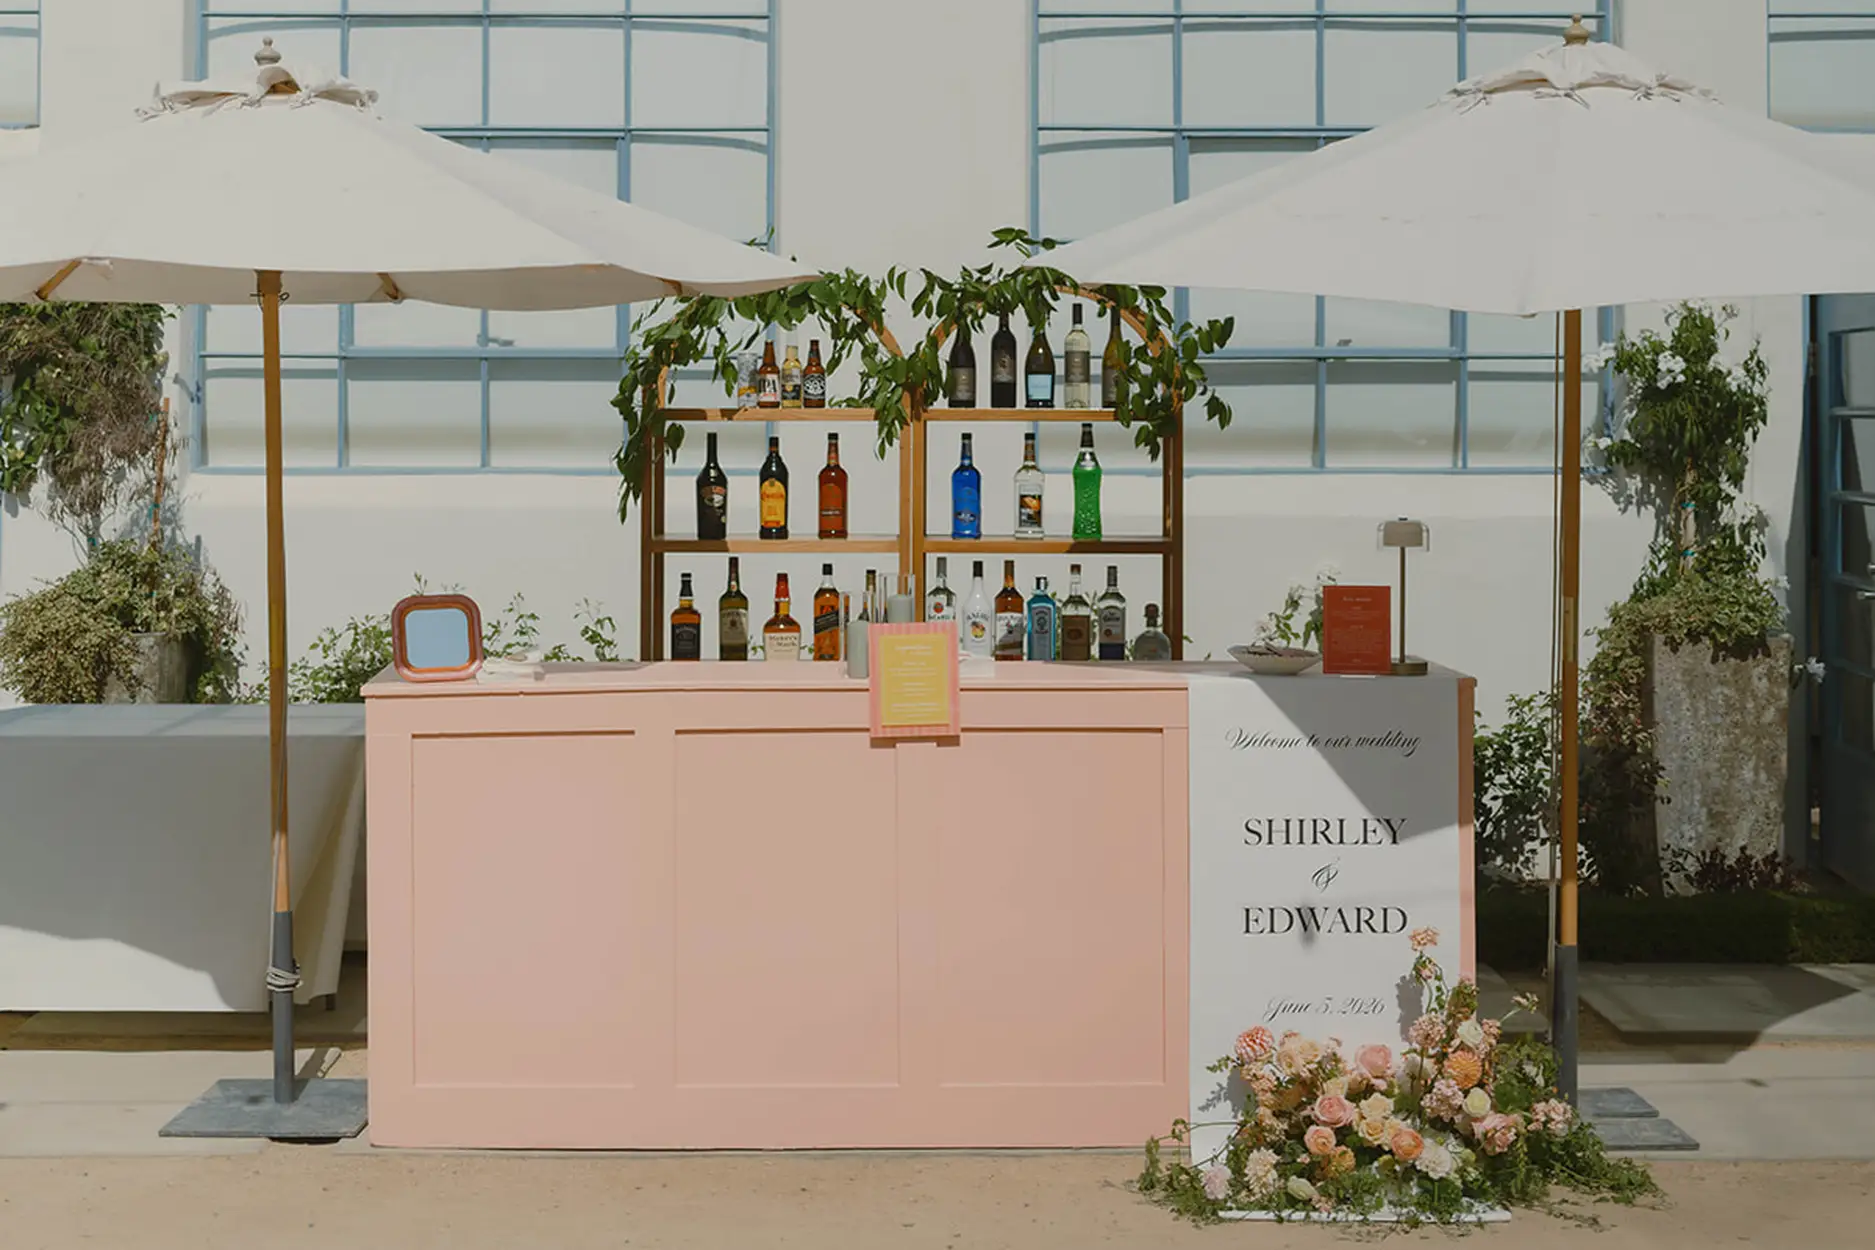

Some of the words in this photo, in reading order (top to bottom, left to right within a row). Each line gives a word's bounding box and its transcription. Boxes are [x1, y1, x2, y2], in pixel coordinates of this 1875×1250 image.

[1225, 727, 1302, 750] Welcome
[1305, 733, 1320, 748] to
[1324, 733, 1352, 748] our
[1355, 729, 1421, 758] wedding
[1243, 817, 1407, 846] SHIRLEY
[1311, 855, 1341, 894] &
[1243, 906, 1409, 934] EDWARD
[1263, 997, 1312, 1022] June
[1336, 997, 1386, 1015] 2026
